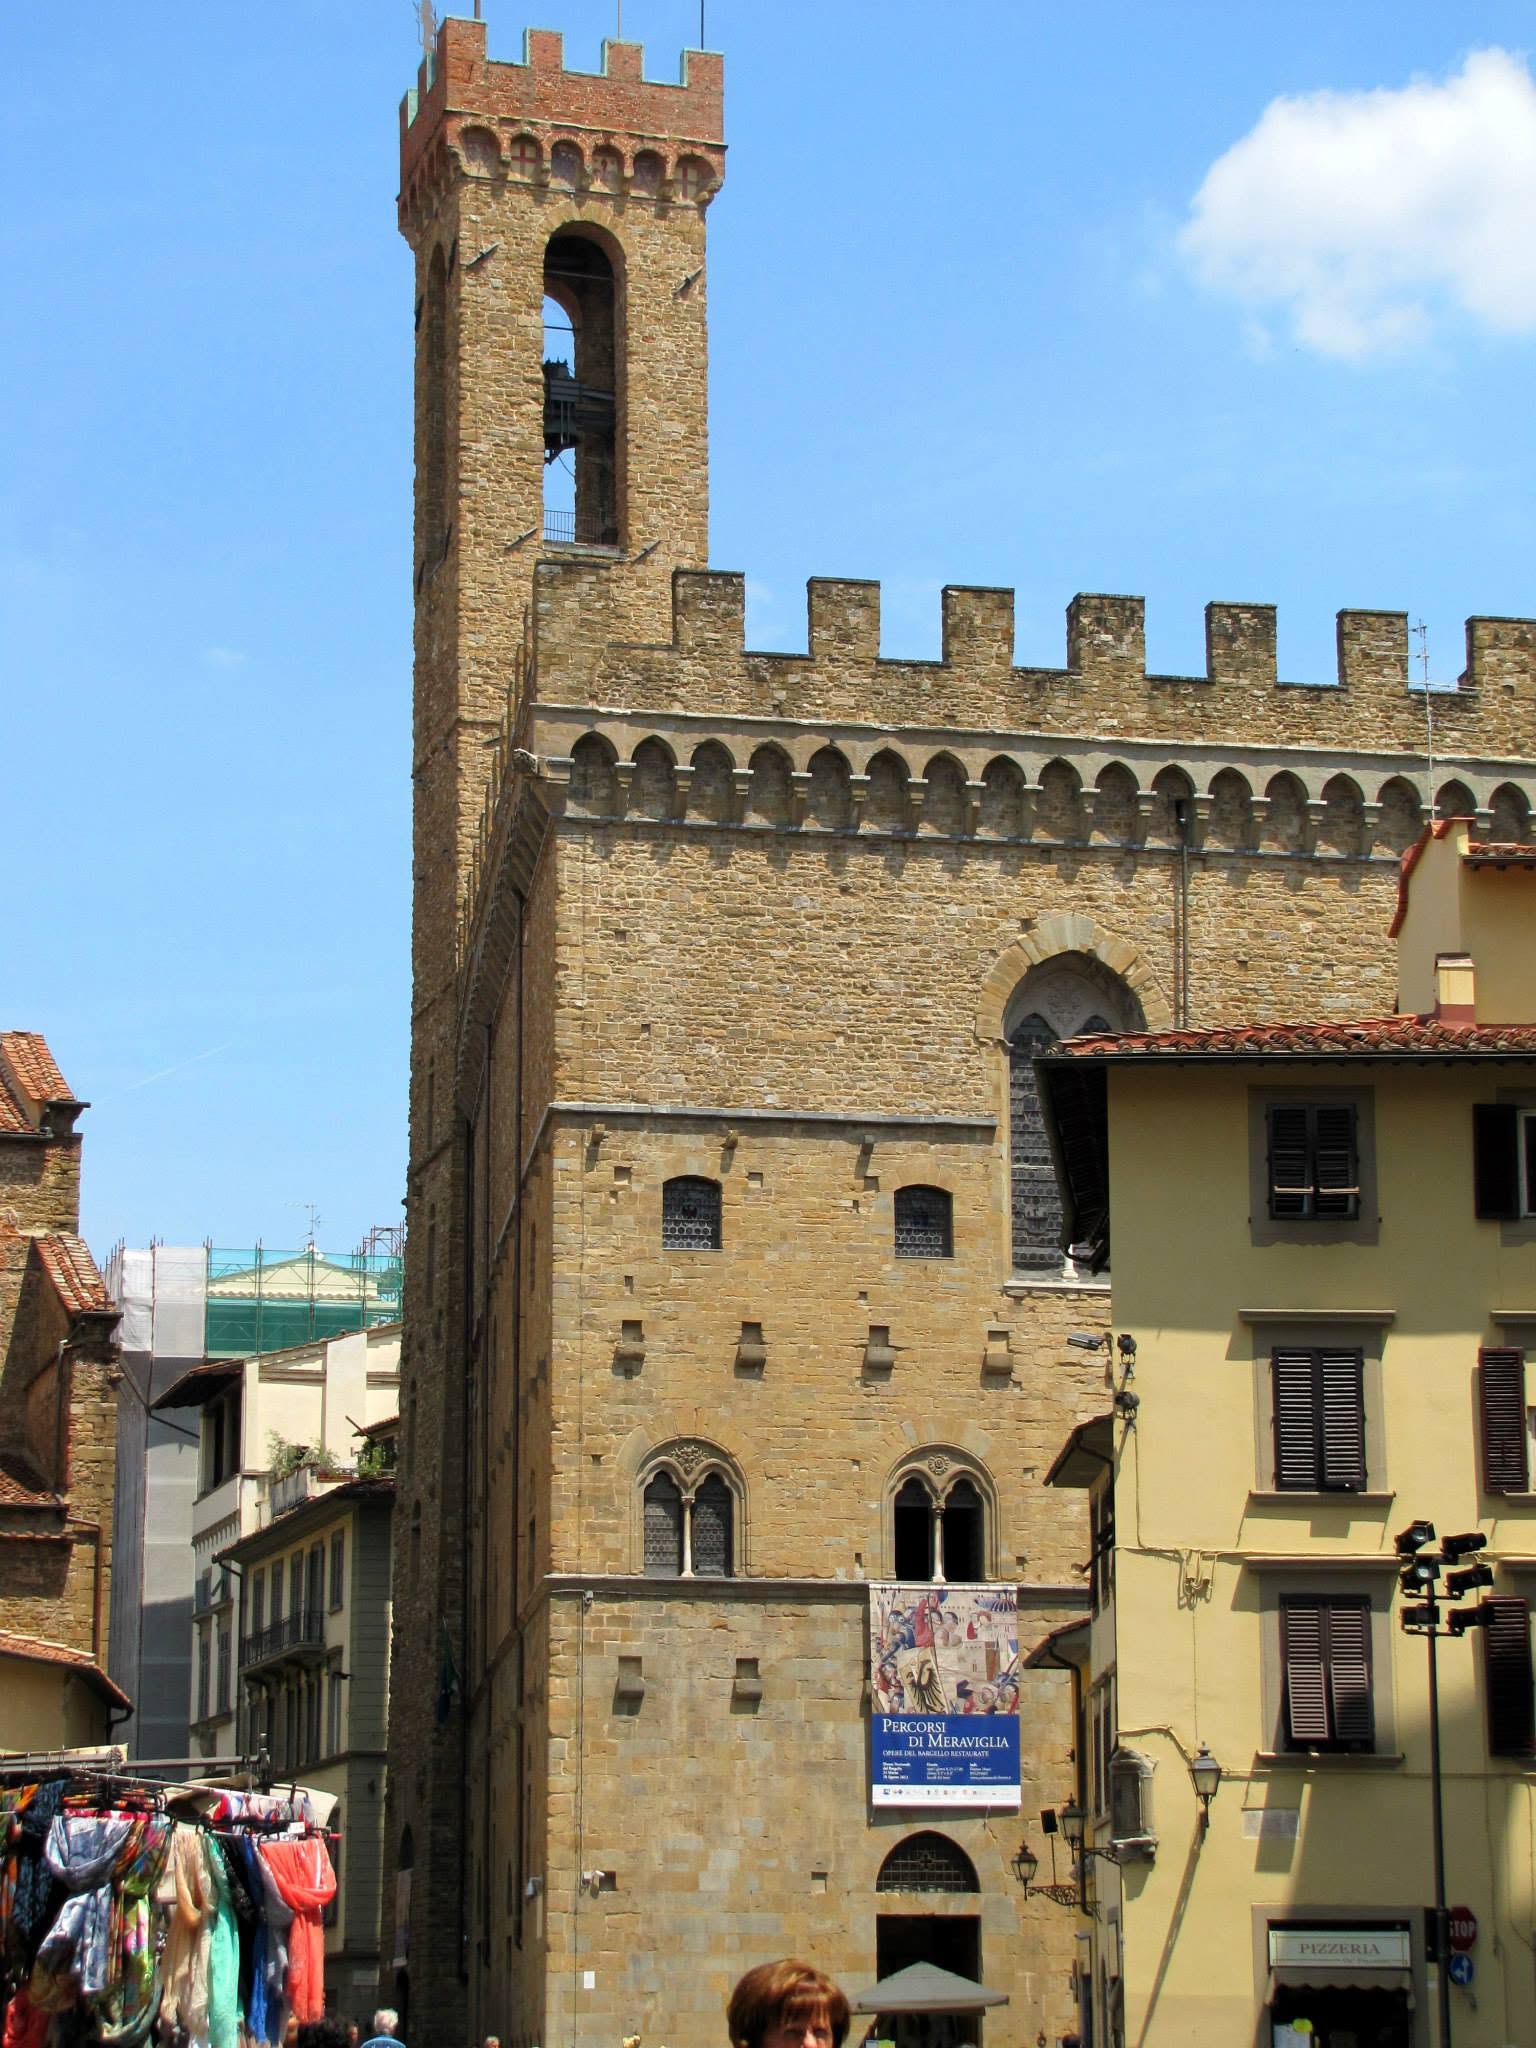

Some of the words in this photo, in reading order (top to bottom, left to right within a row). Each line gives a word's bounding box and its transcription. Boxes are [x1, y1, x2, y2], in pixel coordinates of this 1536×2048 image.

[882, 1718, 946, 1733] PERCORSI
[928, 1734, 1009, 1748] MERAVIGLIA
[950, 1750, 990, 1758] RESTAURATE
[1299, 1943, 1381, 1955] PIZZERIA
